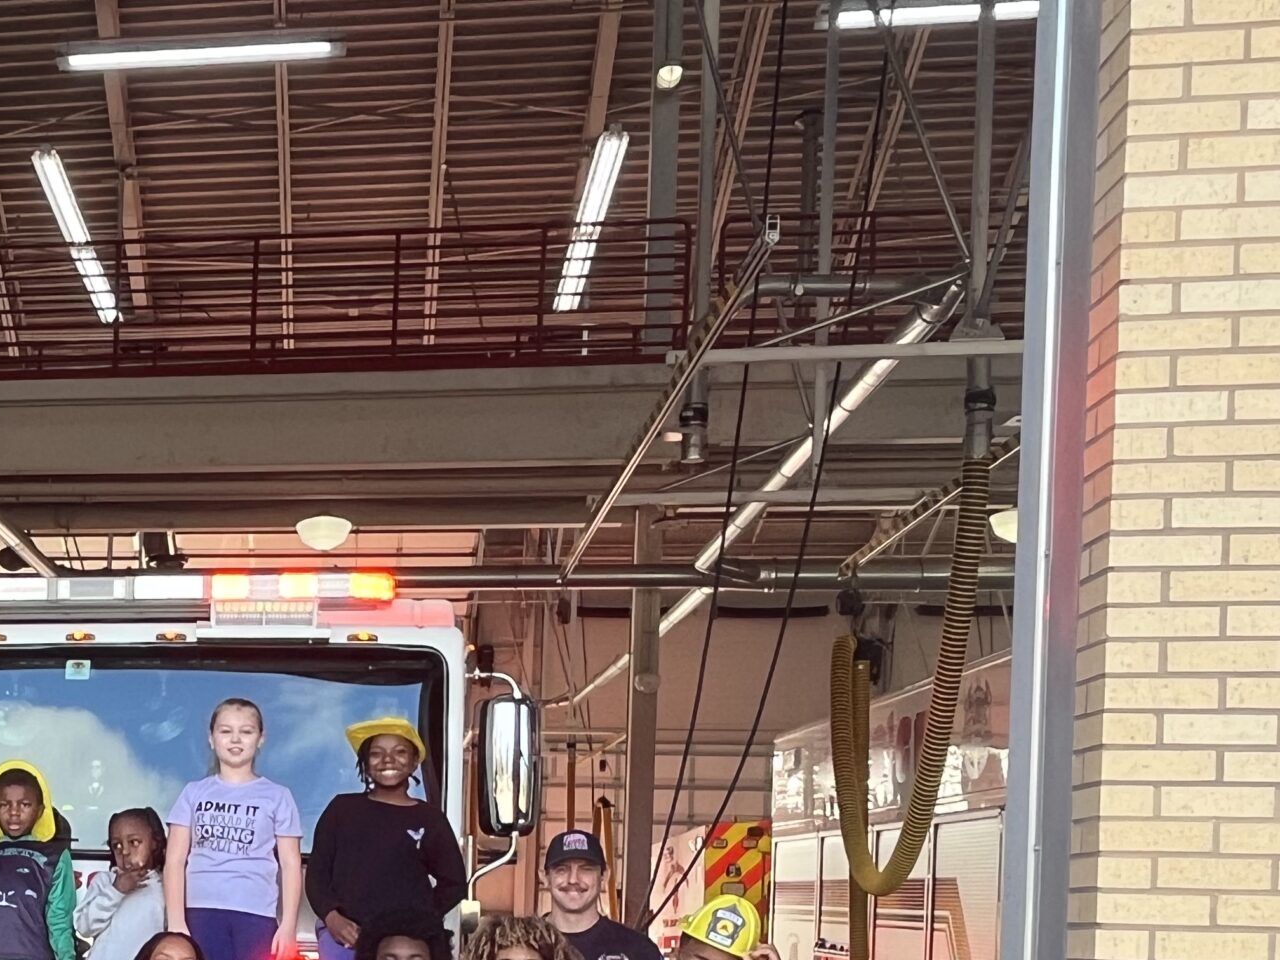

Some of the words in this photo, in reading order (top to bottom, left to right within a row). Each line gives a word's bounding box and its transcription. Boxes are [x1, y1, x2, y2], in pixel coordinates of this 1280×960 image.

[195, 800, 241, 815] ADMIT
[246, 805, 260, 817] IT
[195, 824, 254, 844] BORING
